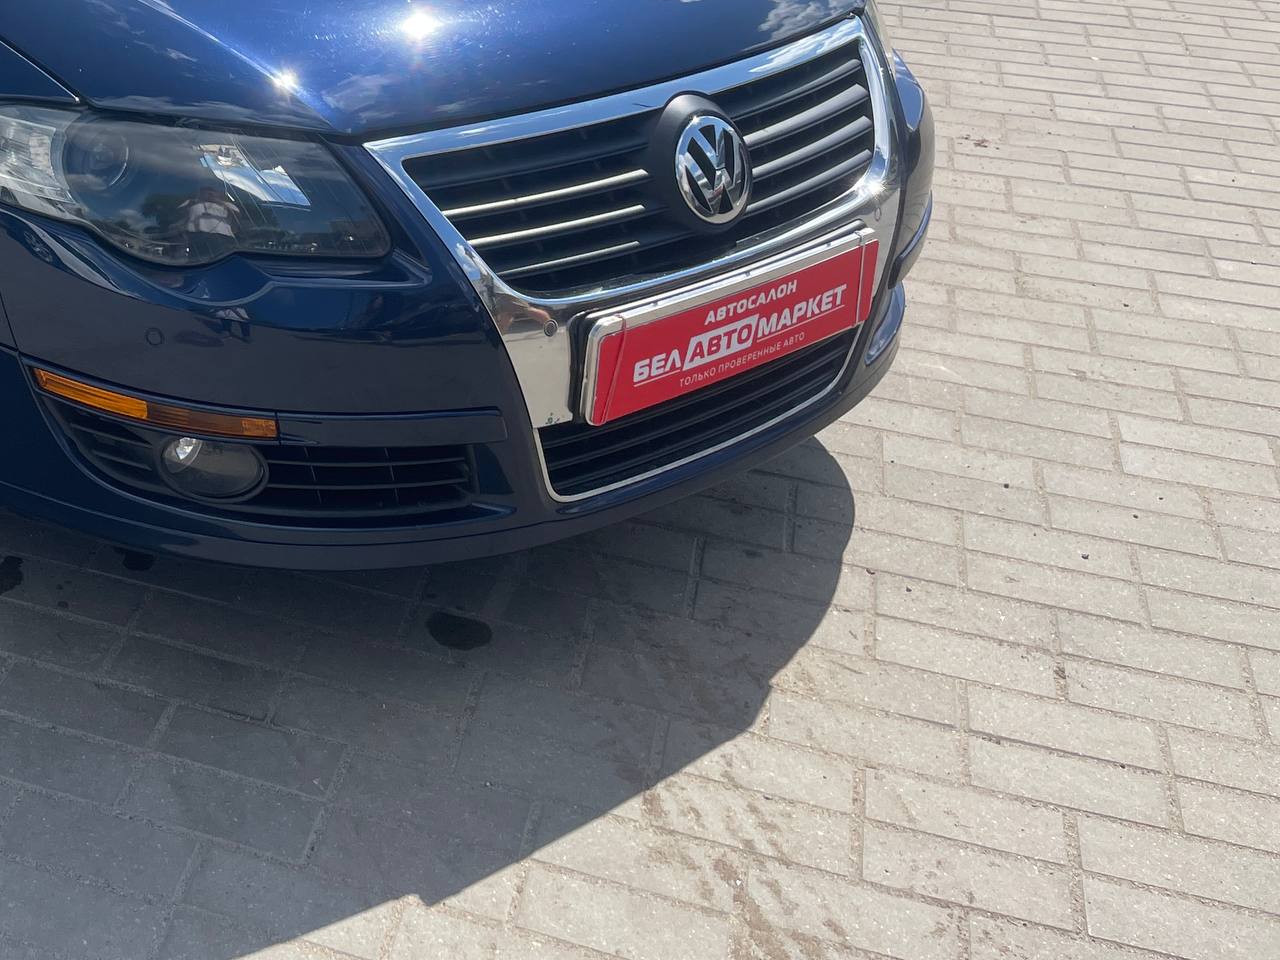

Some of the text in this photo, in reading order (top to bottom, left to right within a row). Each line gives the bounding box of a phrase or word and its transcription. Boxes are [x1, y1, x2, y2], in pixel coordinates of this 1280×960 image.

[704, 280, 798, 325] АВТОСАЛОН
[679, 331, 806, 387] ТОЛЬКО ПРОВЕРЕННЫЕ АВТО
